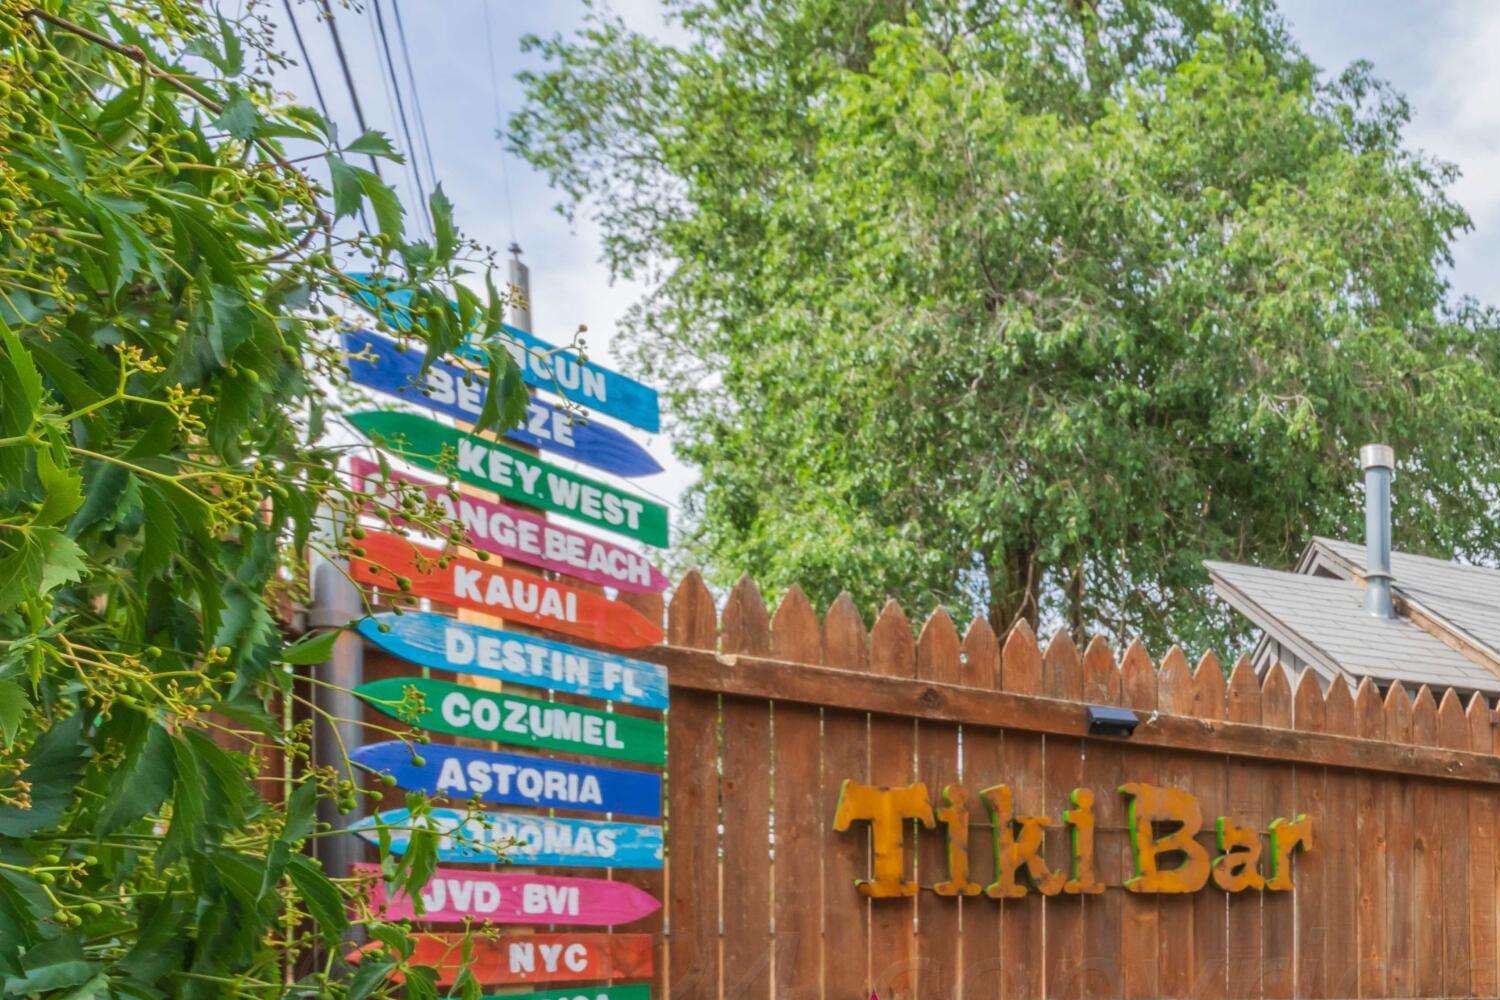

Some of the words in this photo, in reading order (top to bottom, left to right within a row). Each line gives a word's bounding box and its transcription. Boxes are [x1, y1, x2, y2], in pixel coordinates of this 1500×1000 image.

[468, 318, 607, 403] NCUN
[424, 368, 577, 449] BEZE
[456, 437, 540, 496] KEY
[547, 473, 645, 530] WEST
[543, 536, 651, 586] BEACH
[453, 565, 578, 623] KAUAI
[444, 628, 590, 687] DESTIN
[602, 661, 645, 697] FL
[440, 692, 626, 750] COZUMEL
[435, 757, 604, 806] ASTORIA
[833, 778, 1105, 899] Tiki
[1118, 782, 1313, 894] Bar
[423, 878, 501, 913] JVD
[522, 883, 580, 916] BVI
[508, 942, 588, 974] NYC
